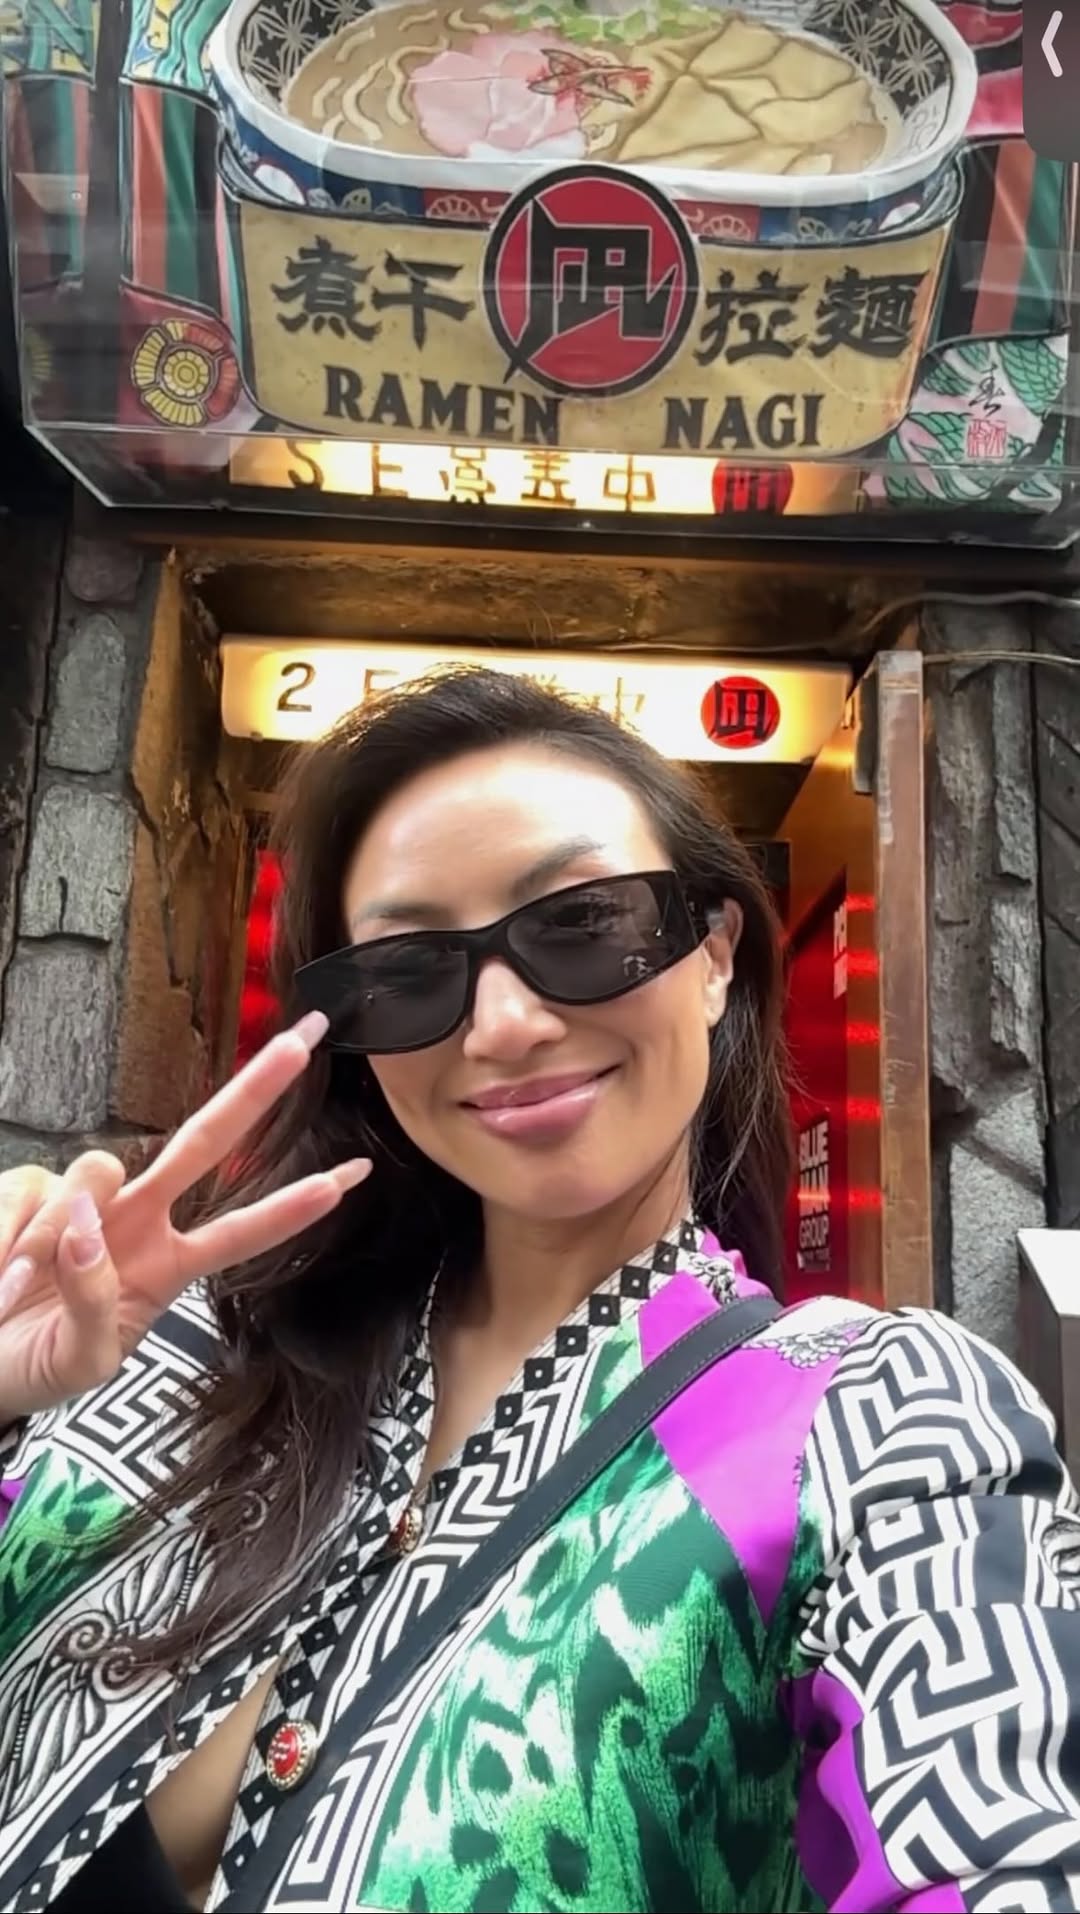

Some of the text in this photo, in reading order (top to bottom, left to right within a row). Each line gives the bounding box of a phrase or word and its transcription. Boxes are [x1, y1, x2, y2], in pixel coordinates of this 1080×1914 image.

[323, 364, 825, 451] RAMEN NAGI
[799, 1120, 828, 1173] BLUE
[799, 1214, 829, 1249] GROUP
